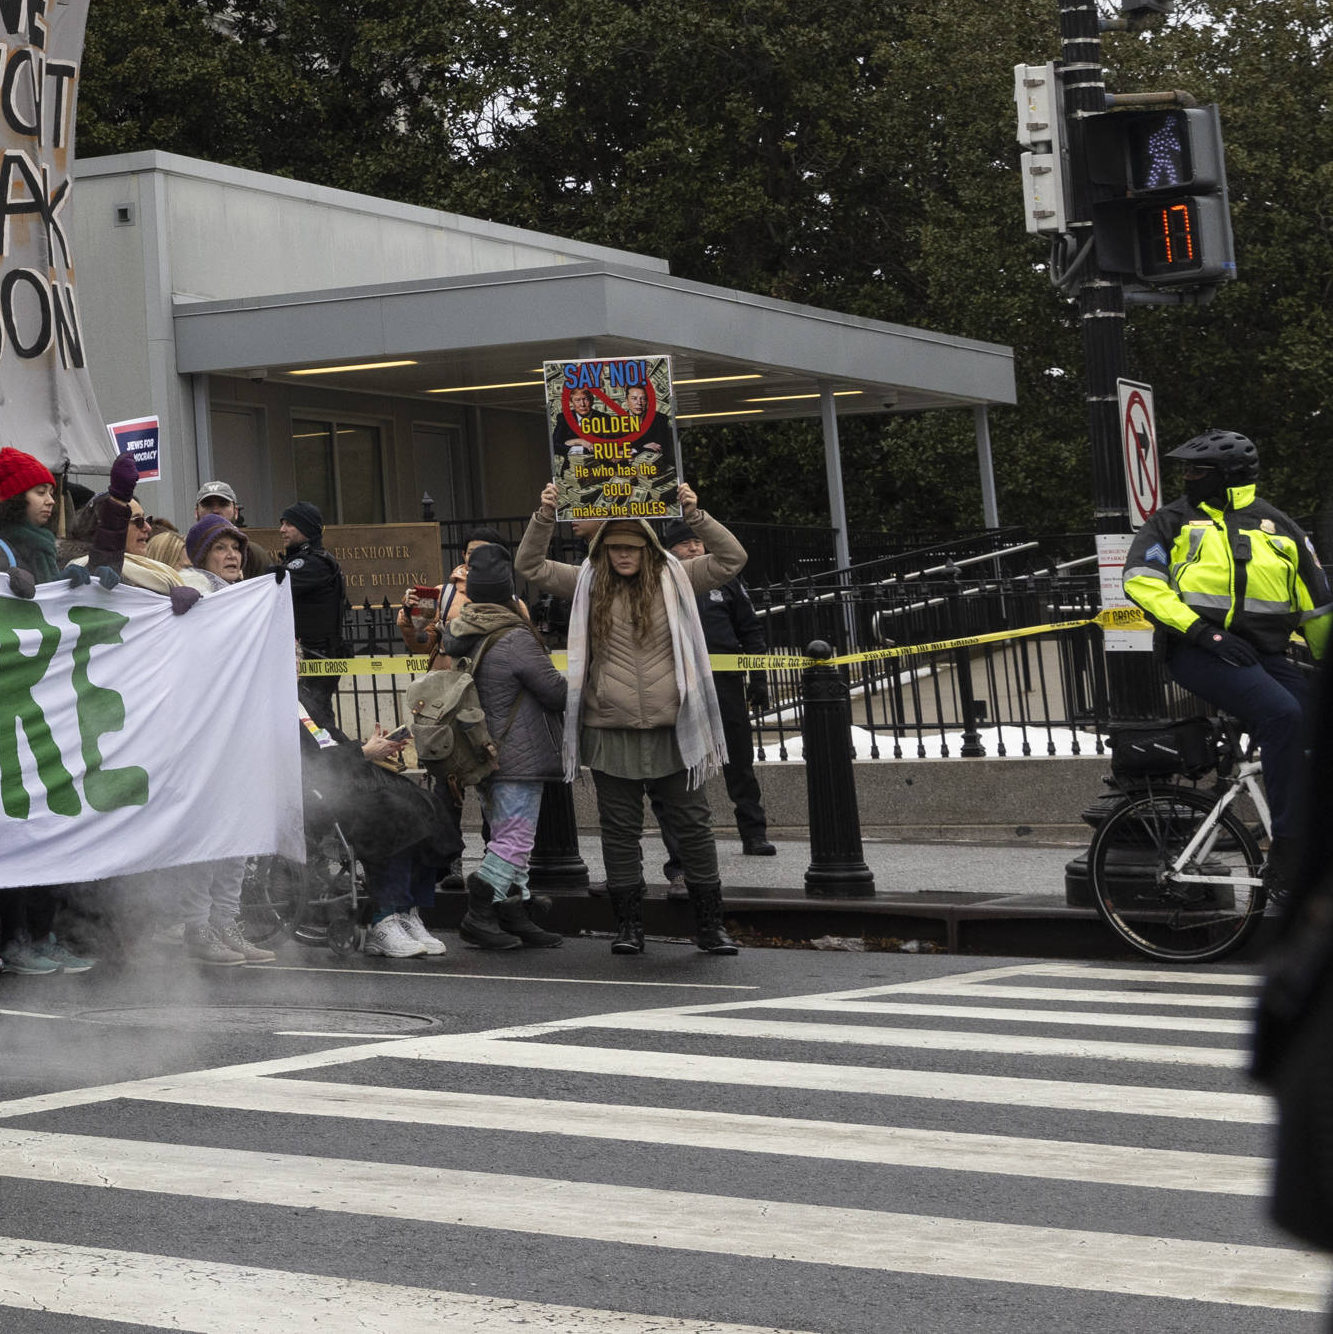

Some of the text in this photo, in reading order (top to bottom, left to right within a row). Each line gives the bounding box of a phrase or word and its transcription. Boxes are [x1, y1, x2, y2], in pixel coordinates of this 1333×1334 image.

[1162, 204, 1193, 263] 17
[564, 359, 647, 389] SAY NO!
[582, 416, 640, 434] GOLDEN
[127, 438, 154, 451] JEWS FOR
[594, 442, 632, 459] RULE
[575, 463, 657, 478] He who has the
[603, 483, 632, 496] GOLD
[573, 502, 666, 517] makes the RULES
[335, 545, 410, 560] EISENHOWER
[372, 573, 427, 586] BUILDING
[1113, 610, 1142, 624] CROSS
[309, 662, 323, 674] NOT
[324, 661, 348, 674] CROSS
[406, 659, 430, 671] POLIC
[737, 657, 766, 669] POLICE
[768, 657, 786, 668] LINE
